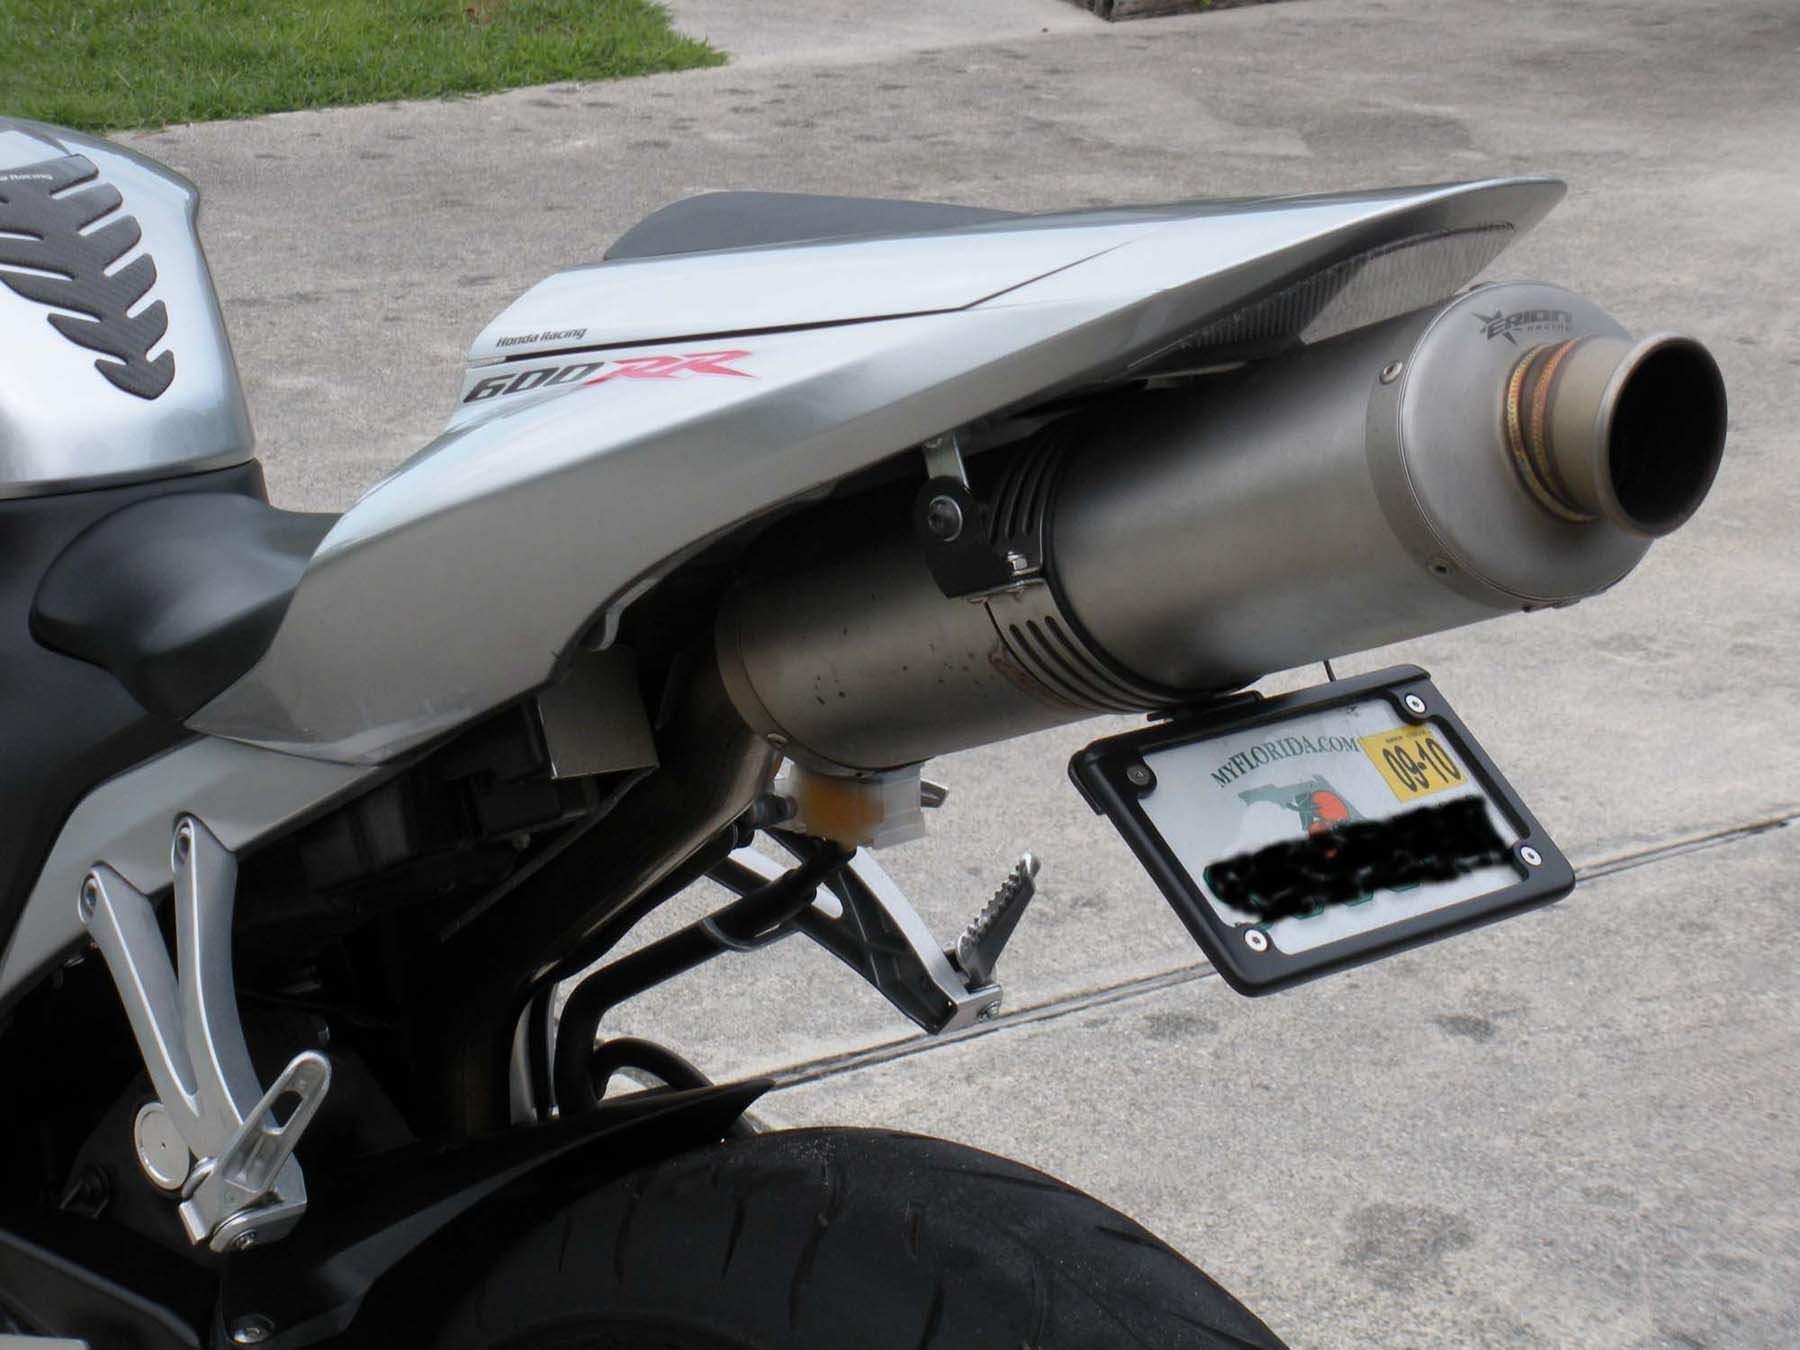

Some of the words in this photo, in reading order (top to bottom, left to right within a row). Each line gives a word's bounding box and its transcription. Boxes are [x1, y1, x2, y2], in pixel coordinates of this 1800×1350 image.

[496, 334, 539, 348] Honda
[540, 328, 587, 341] Racing
[1211, 735, 1360, 788] MYFLORIDA.COM
[1382, 738, 1461, 792] 09-10
